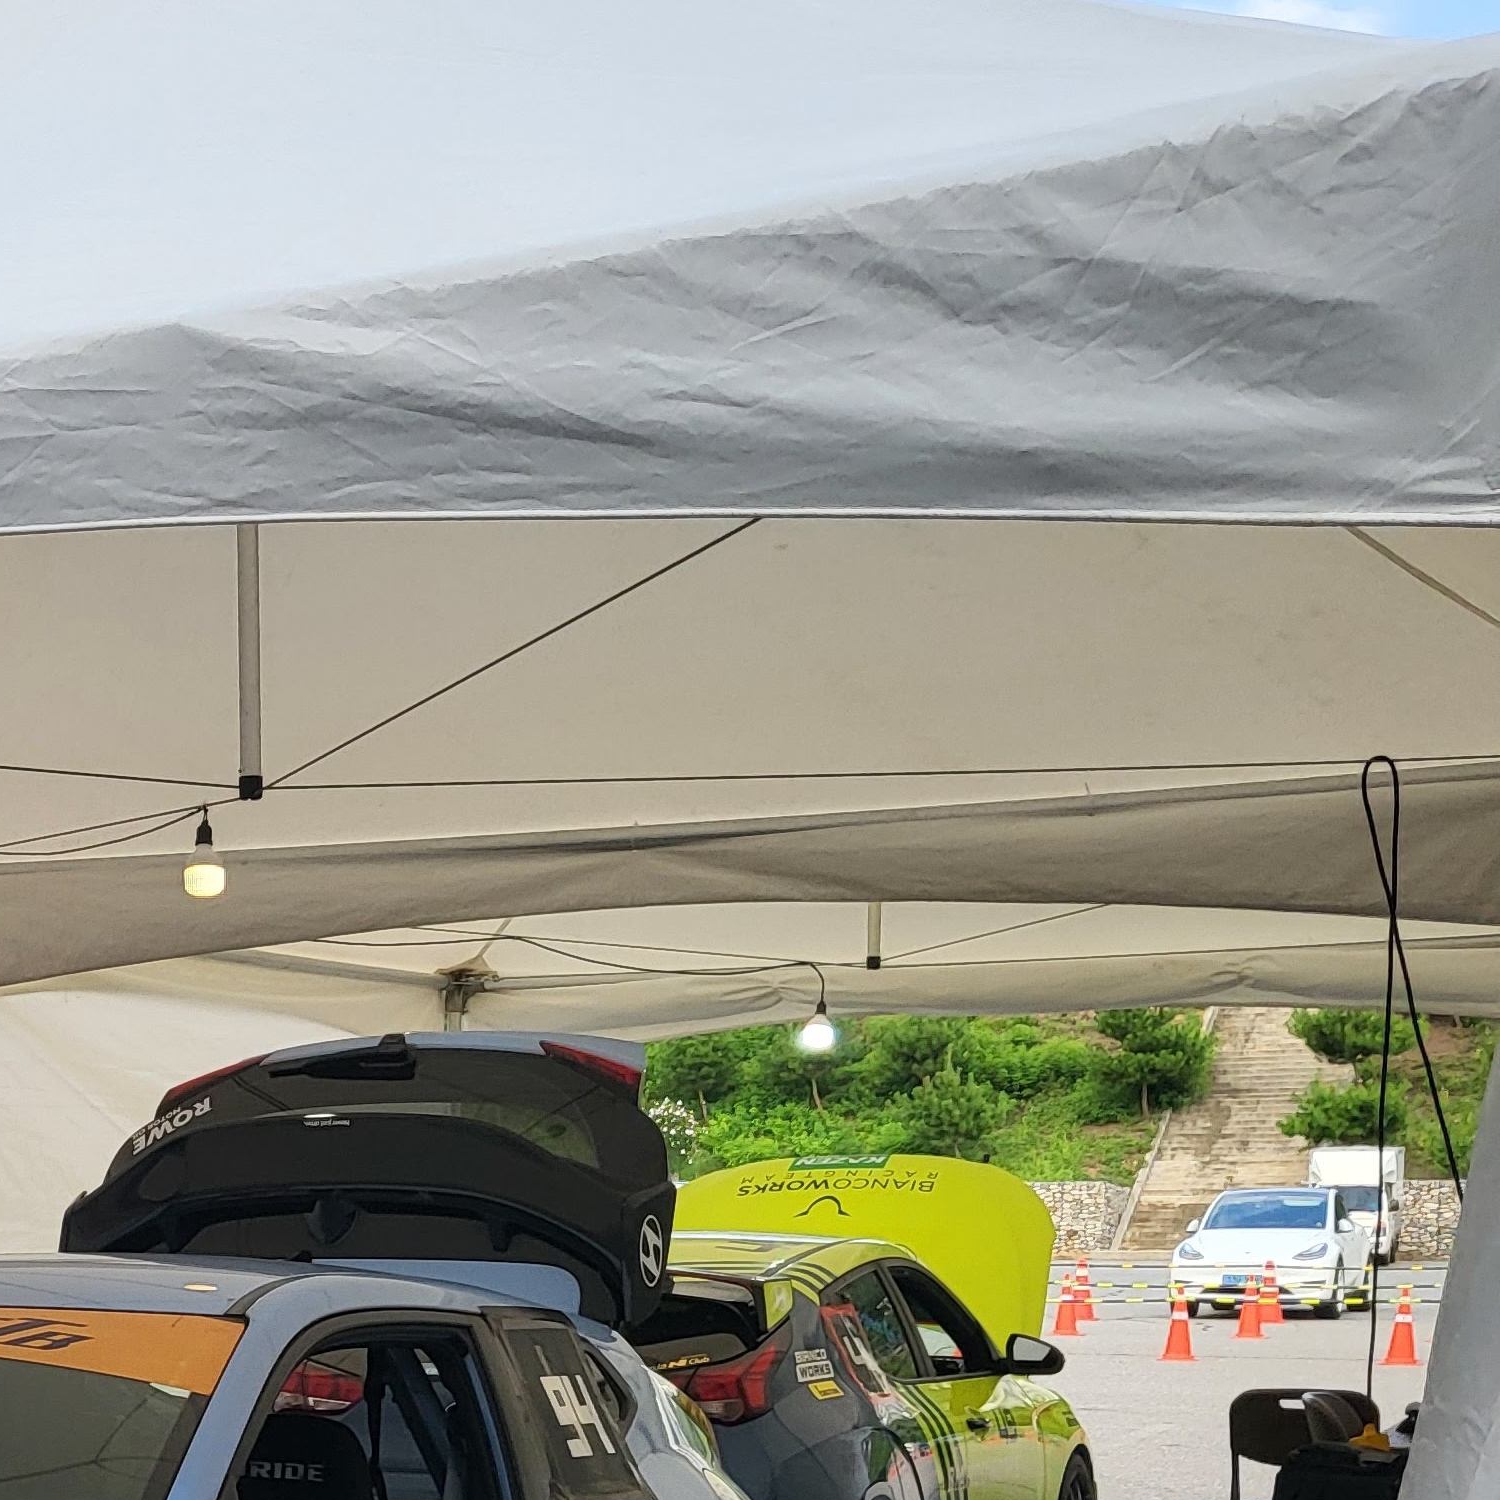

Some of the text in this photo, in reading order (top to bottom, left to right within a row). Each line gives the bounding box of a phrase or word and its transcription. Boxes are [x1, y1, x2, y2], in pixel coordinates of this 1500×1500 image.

[132, 1096, 213, 1156] ROWE
[796, 1155, 887, 1166] KAZEN
[737, 1178, 936, 1197] BIANCOWORKS
[540, 1374, 617, 1459] 94
